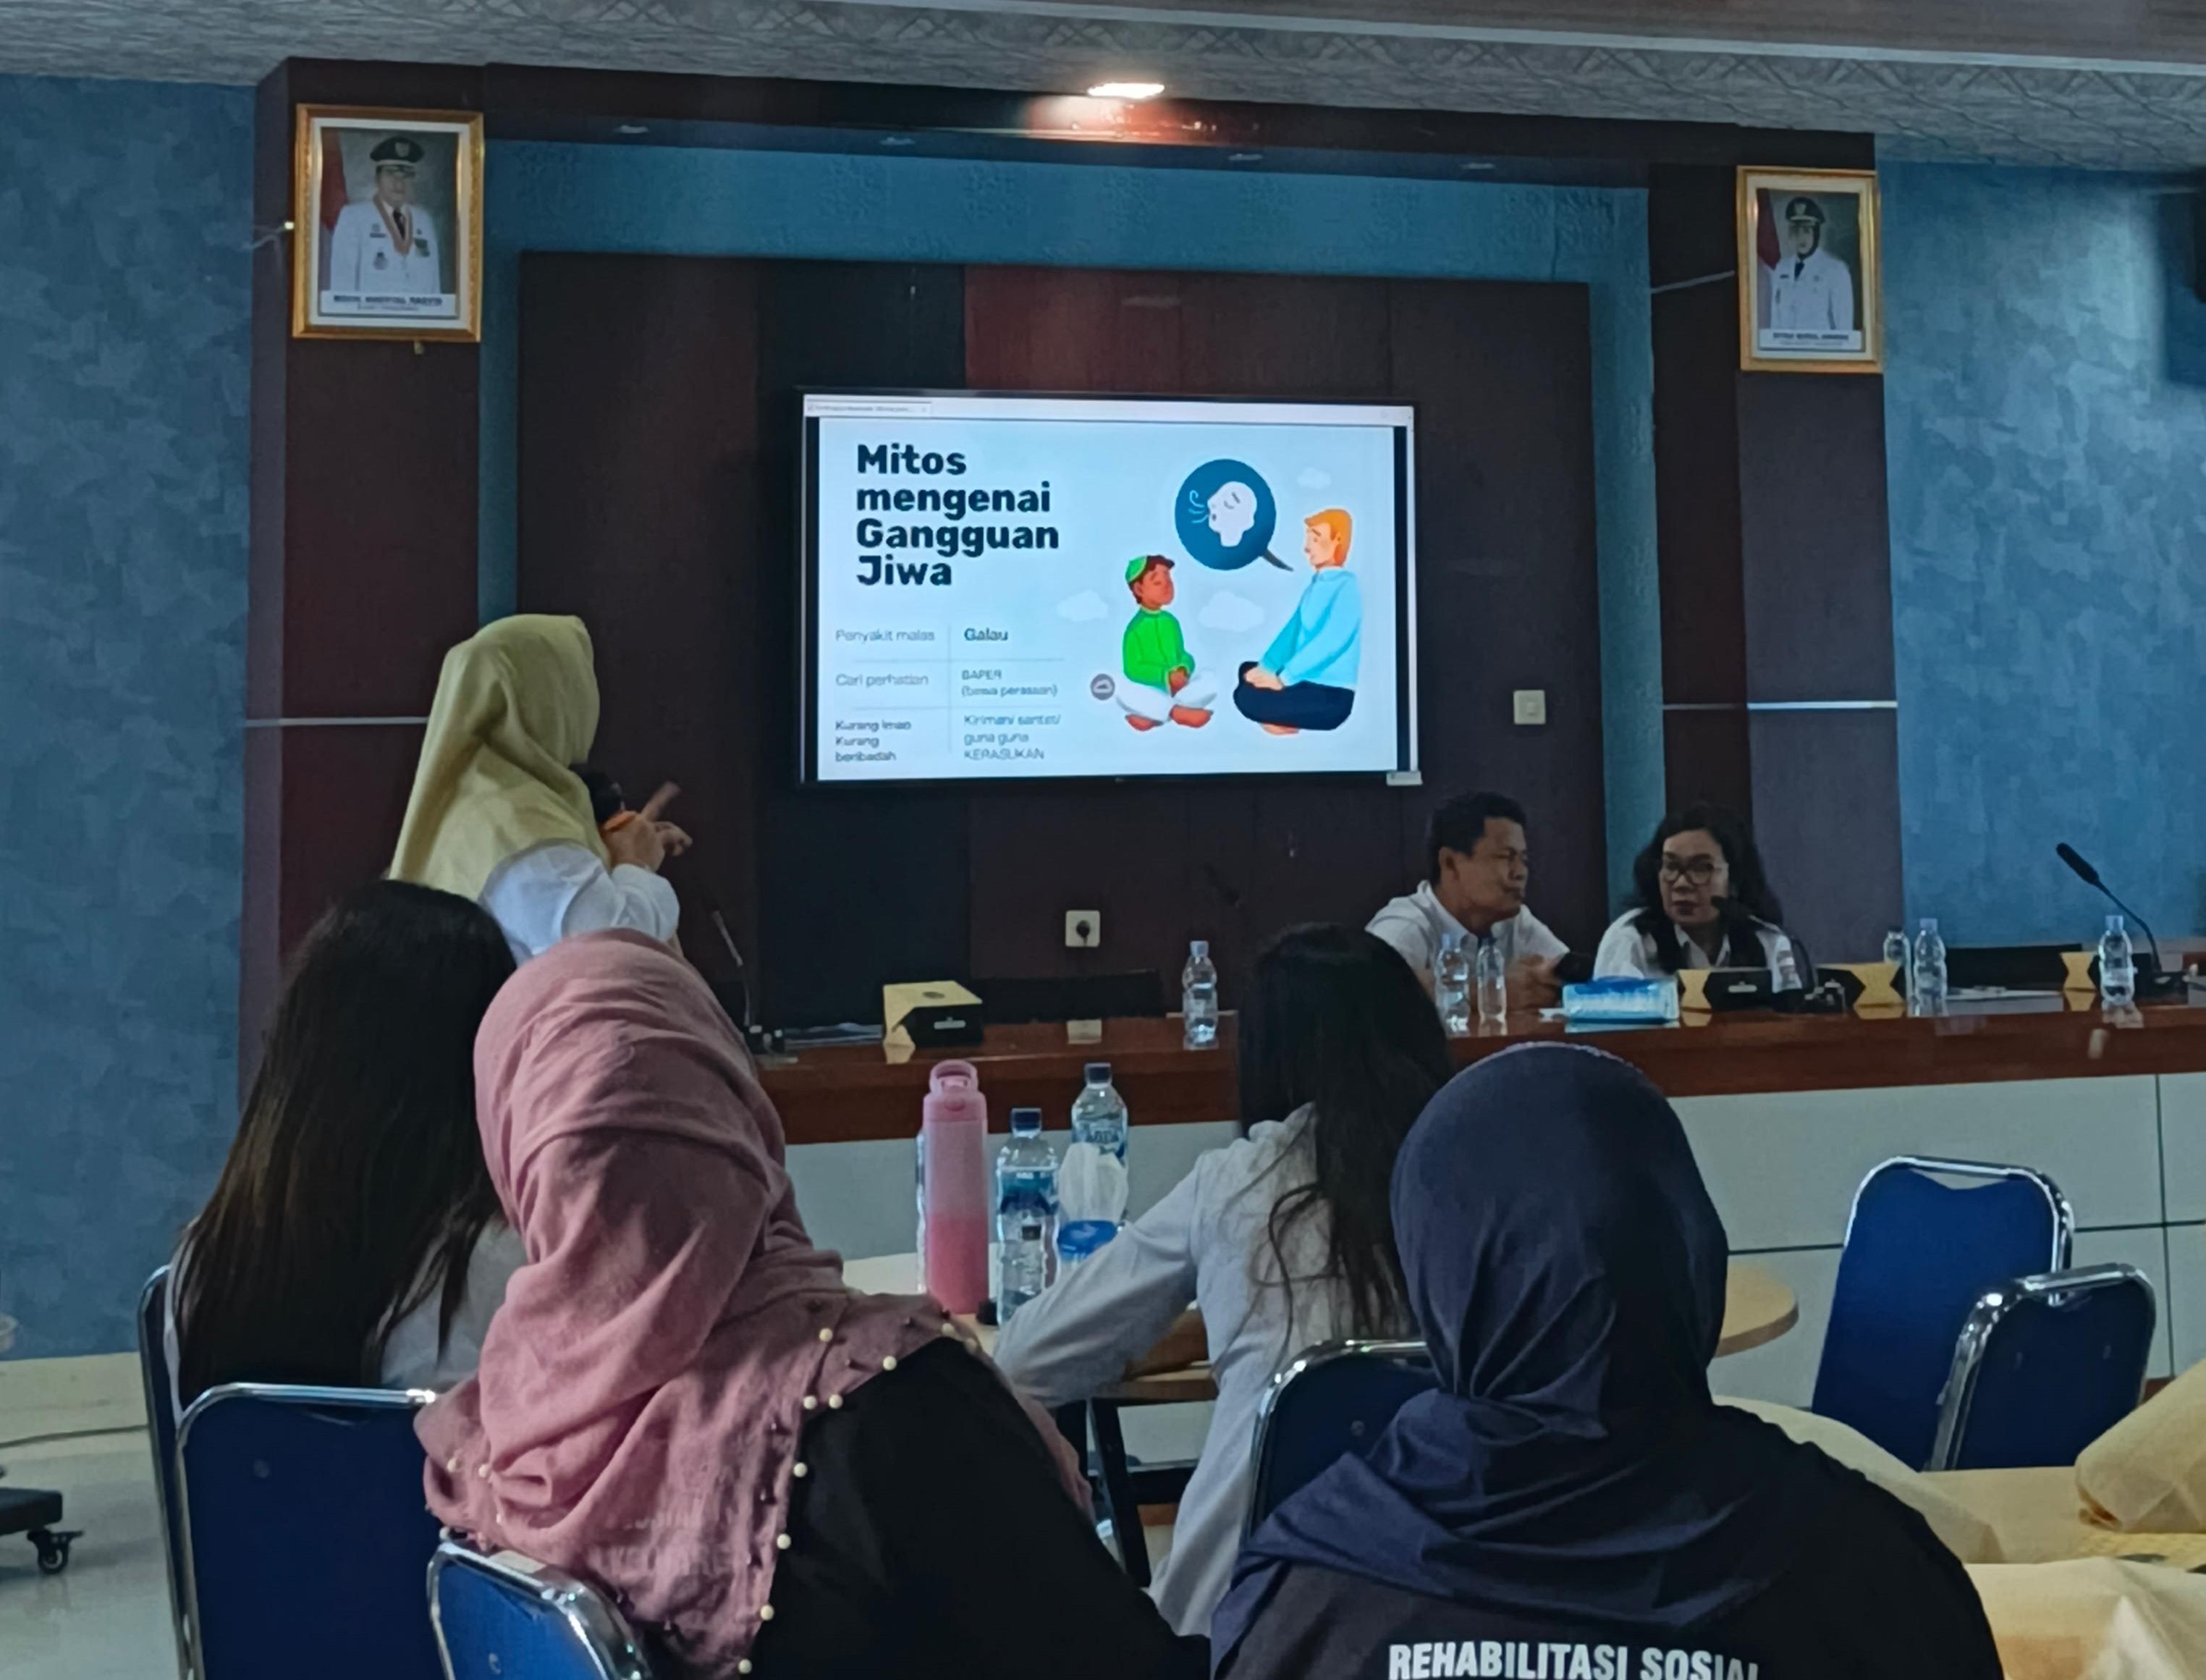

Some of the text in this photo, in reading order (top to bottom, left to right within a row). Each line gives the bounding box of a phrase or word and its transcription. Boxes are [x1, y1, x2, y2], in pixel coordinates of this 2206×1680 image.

[857, 442, 967, 476] Mitos
[856, 481, 1051, 521] mengenai
[856, 518, 1060, 558] Gangguan
[856, 554, 952, 586] Jiwa
[835, 628, 935, 644] Penyakit malas
[963, 628, 1008, 642] Galau
[835, 673, 929, 688] Cari perhatian
[835, 720, 879, 733] Kurang
[835, 736, 880, 748] Kurang
[1389, 1641, 1628, 1680] REHABILITASI
